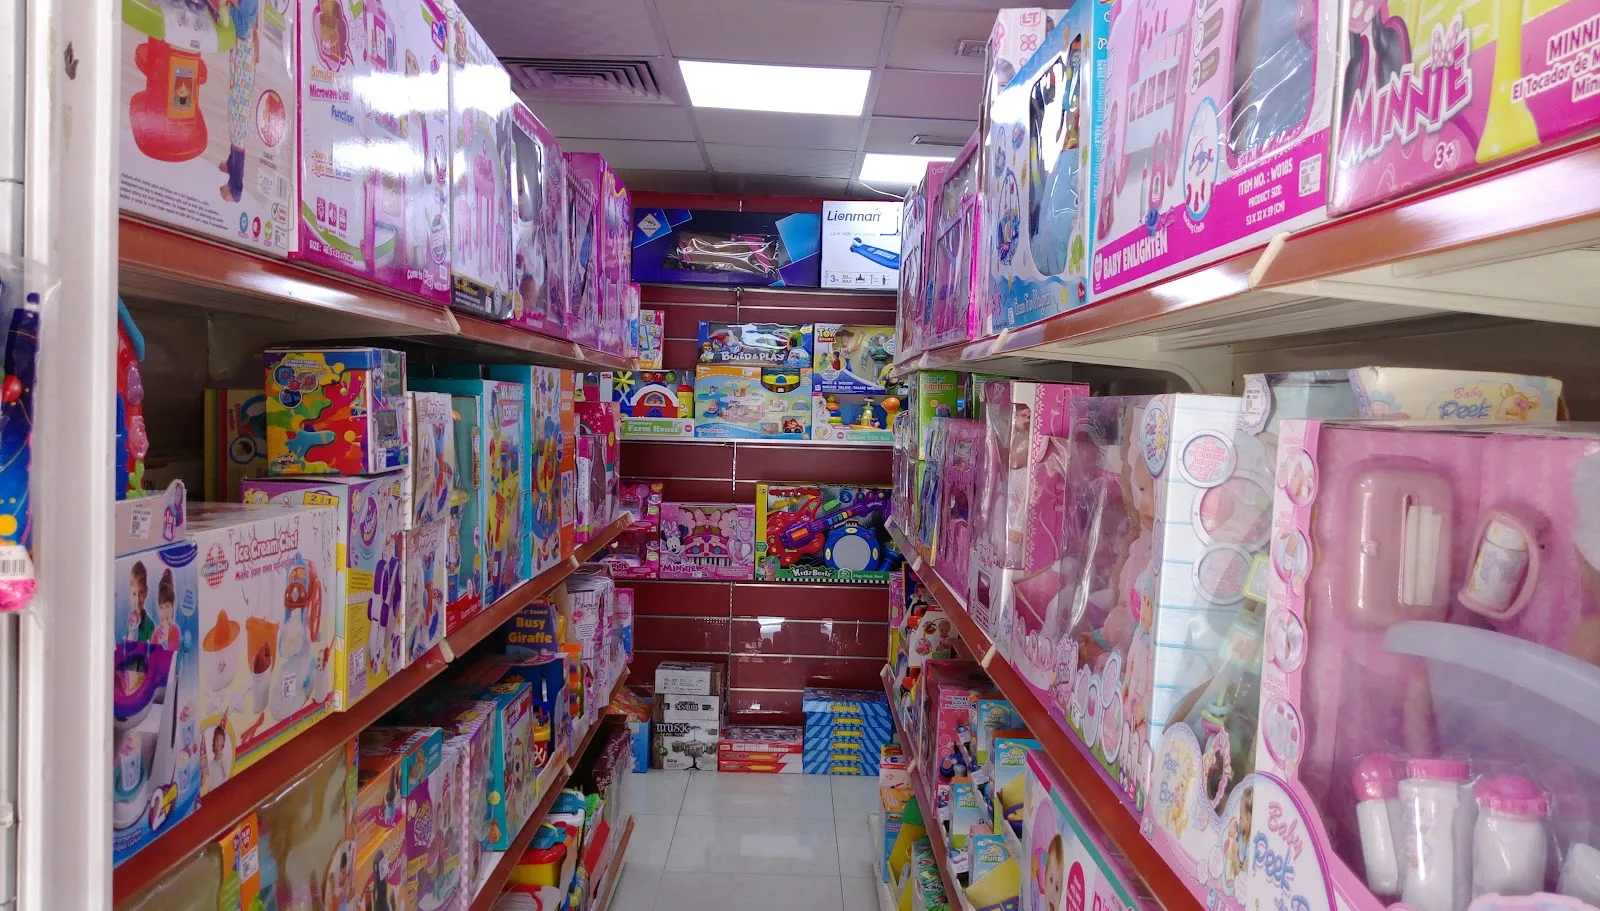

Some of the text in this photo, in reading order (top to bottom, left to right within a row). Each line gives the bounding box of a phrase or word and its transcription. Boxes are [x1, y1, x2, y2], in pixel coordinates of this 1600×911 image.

[1526, 65, 1569, 95] Tocador
[1573, 50, 1589, 74] de
[309, 85, 338, 100] Microwave
[1340, 27, 1473, 169] MINNIE
[331, 105, 355, 126] Function
[1434, 142, 1455, 169] 3+
[1238, 177, 1253, 197] ITEM
[1253, 172, 1266, 189] NO.
[1248, 190, 1271, 208] PRODUCT
[827, 210, 881, 222] Lionman
[1103, 228, 1168, 280] BABY ENLIGHTEN
[817, 328, 836, 337] TOY
[760, 351, 785, 361] PLAY
[923, 383, 954, 391] Kitchen
[1453, 387, 1483, 399] Baby
[1438, 398, 1492, 419] Peek
[627, 425, 651, 433] Farm
[235, 529, 299, 565] Ice Cream Chef
[235, 569, 250, 581] Make
[250, 565, 262, 578] your
[515, 617, 547, 630] Busy
[508, 632, 553, 644] Giraffe
[1267, 800, 1304, 861] Baby
